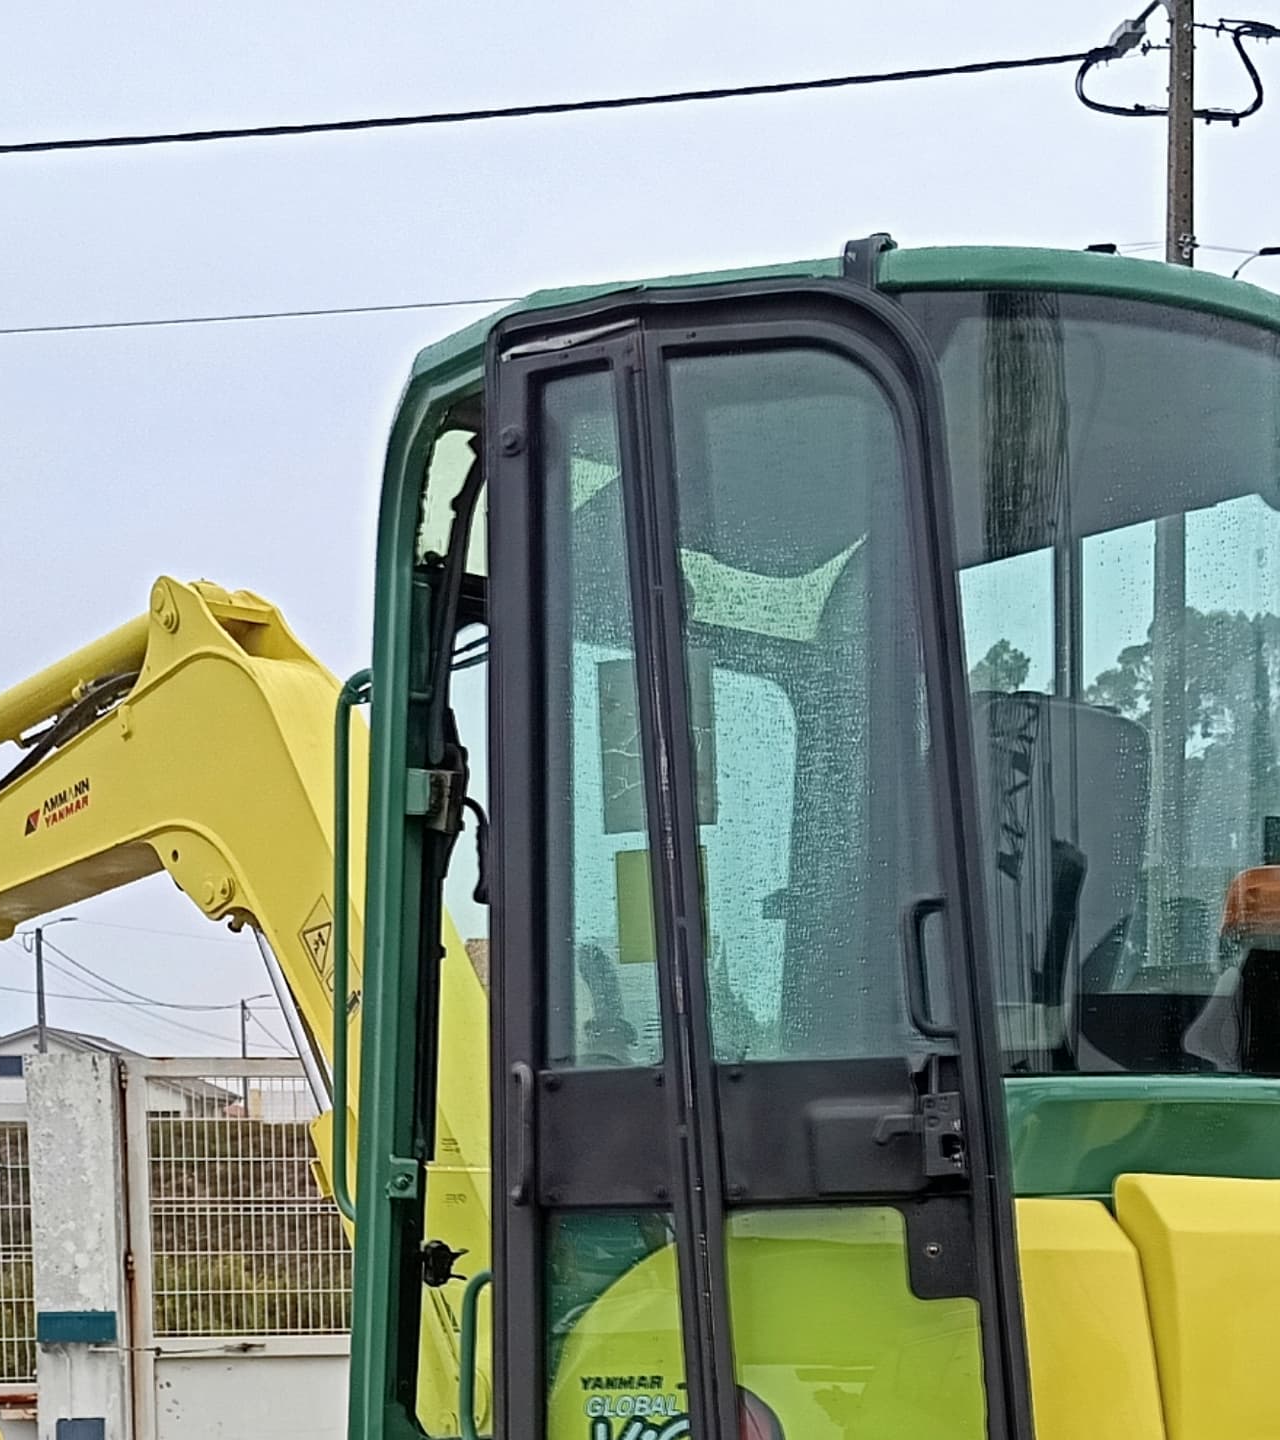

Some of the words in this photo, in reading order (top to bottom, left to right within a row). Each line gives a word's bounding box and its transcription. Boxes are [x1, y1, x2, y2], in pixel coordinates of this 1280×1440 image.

[44, 794, 89, 828] YANMAR
[581, 1375, 663, 1391] YANMAR
[586, 1394, 681, 1418] GLOBAL
